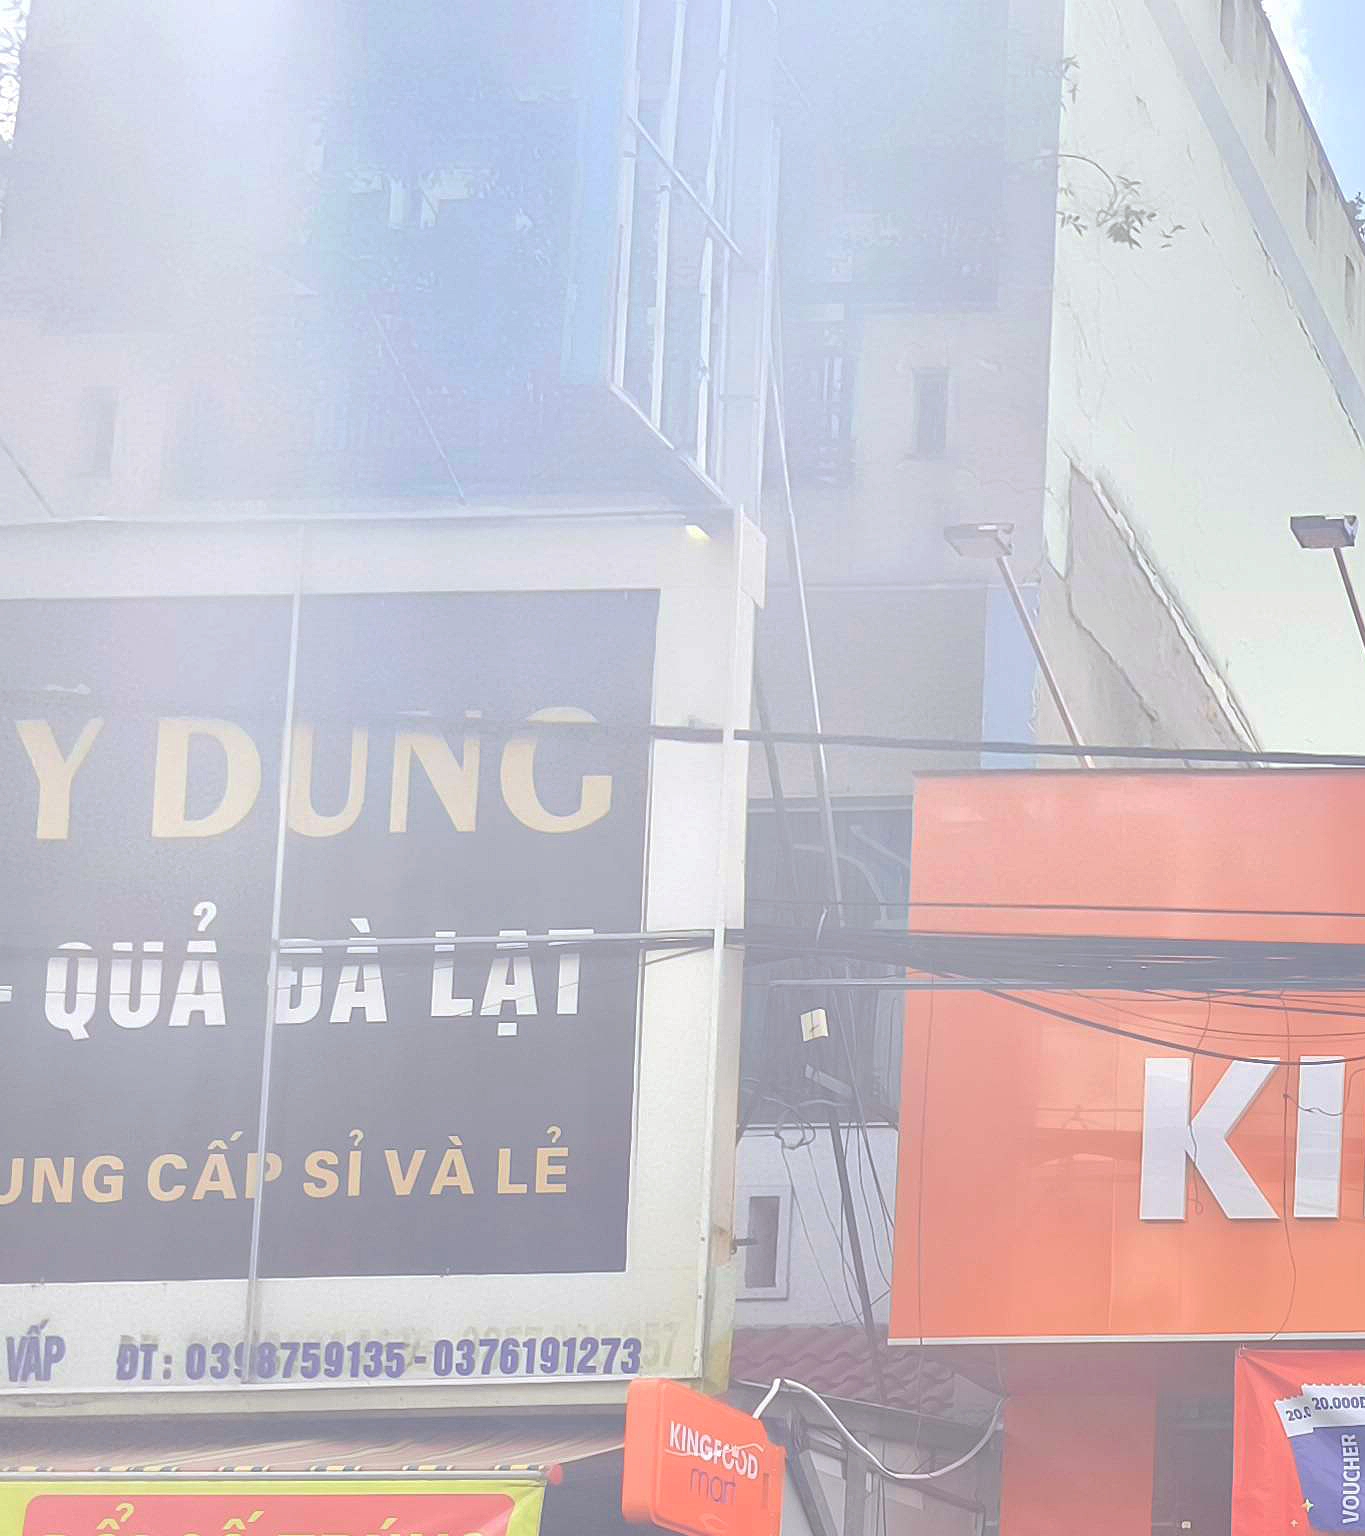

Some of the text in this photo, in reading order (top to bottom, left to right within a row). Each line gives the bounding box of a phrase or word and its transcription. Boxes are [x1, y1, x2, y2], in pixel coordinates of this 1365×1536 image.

[44, 902, 226, 1039] QUẢ
[430, 929, 594, 1036] LẠT
[148, 1131, 283, 1200] CẤP
[303, 1129, 362, 1197] SỈ
[384, 1136, 475, 1195] VÀ
[497, 1126, 569, 1195] LẺ
[5, 1318, 66, 1382] VẤP
[433, 1336, 642, 1376] 0376191273
[669, 1420, 759, 1480] KINGFOOD
[1341, 1434, 1361, 1525] VOUCHER
